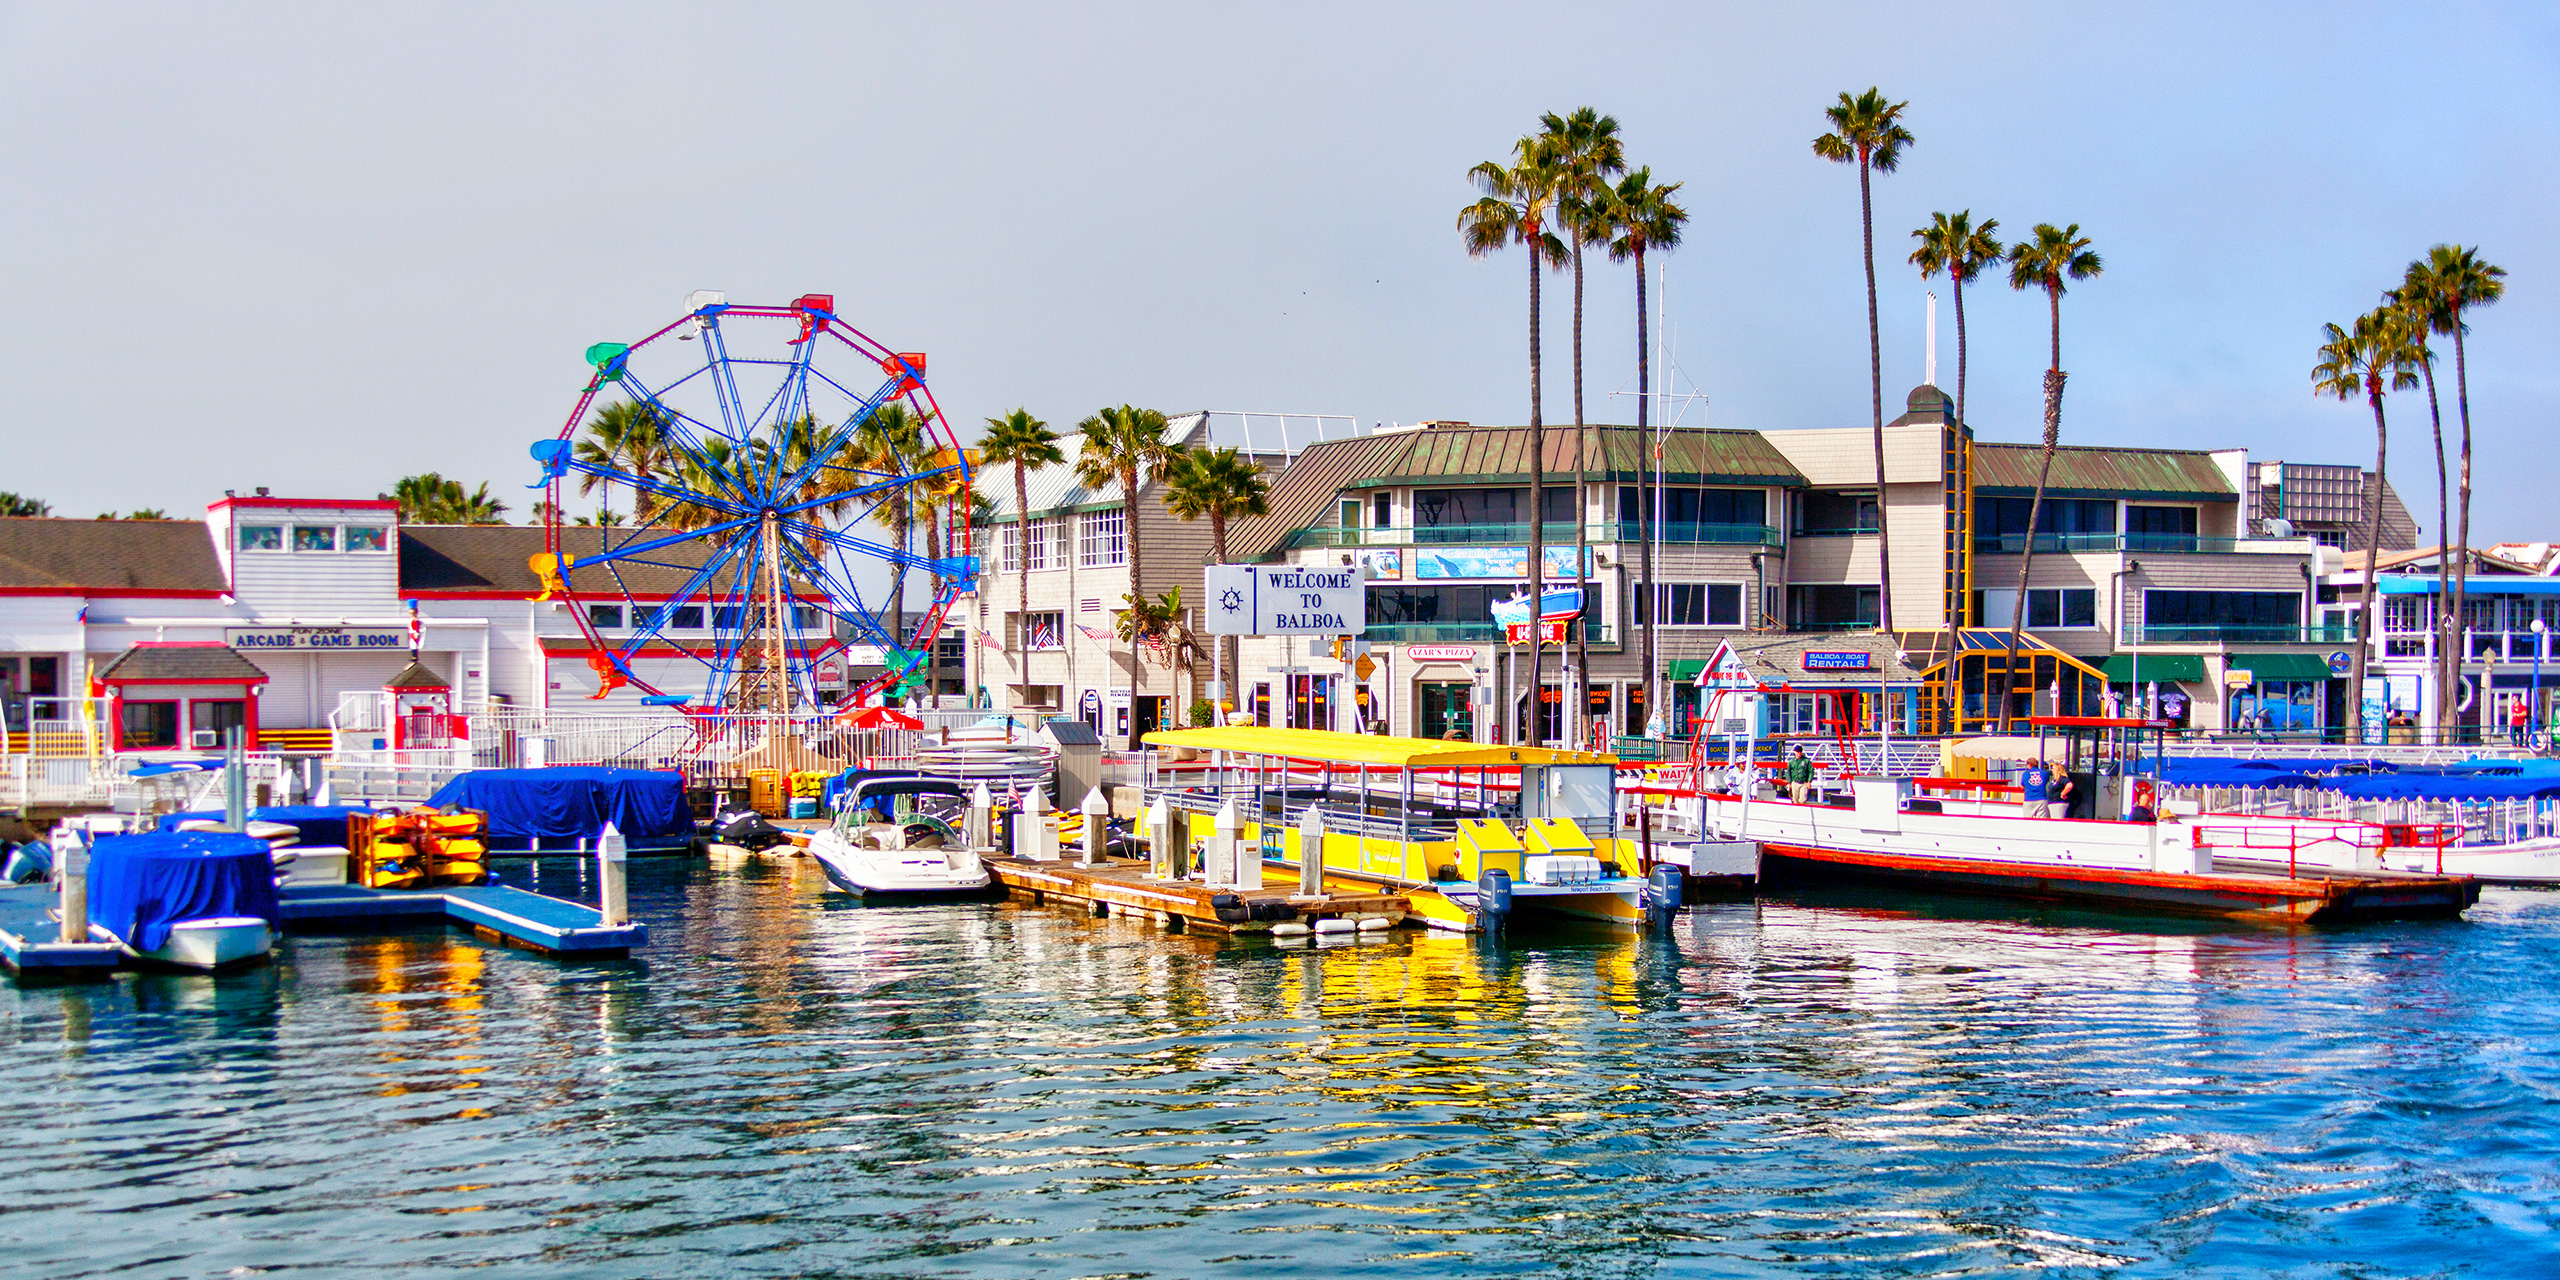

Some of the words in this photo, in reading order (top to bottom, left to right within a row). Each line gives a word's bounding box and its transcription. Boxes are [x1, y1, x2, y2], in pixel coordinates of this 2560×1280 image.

[1269, 573, 1351, 588] WELCOME
[1300, 593, 1322, 608] TO
[1276, 613, 1346, 629] BALBOA
[236, 634, 296, 647] ARCADE
[309, 634, 352, 646] GAME
[358, 634, 399, 646] ROOM
[1411, 648, 1442, 656] AZAR'S
[1445, 648, 1471, 656] PIZZA
[1808, 659, 1865, 668] RENTALS
[1570, 886, 1589, 894] Newport
